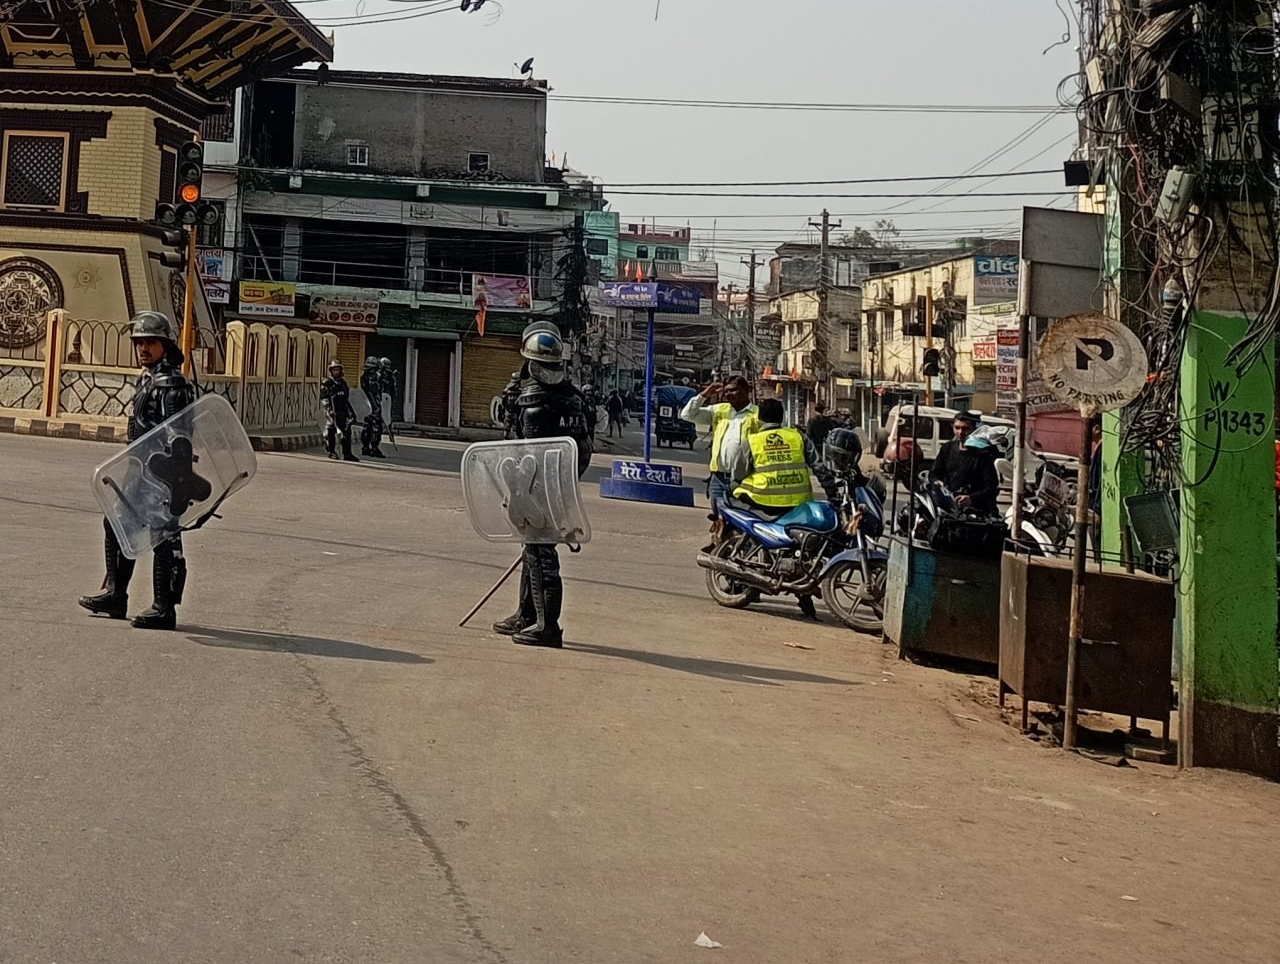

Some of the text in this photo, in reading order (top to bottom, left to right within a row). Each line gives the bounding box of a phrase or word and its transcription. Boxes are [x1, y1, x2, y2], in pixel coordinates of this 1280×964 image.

[1075, 338, 1114, 370] P
[1049, 372, 1065, 389] NO
[1067, 386, 1125, 405] PARKING
[767, 454, 792, 462] PRESS
[621, 462, 641, 480] मेरो
